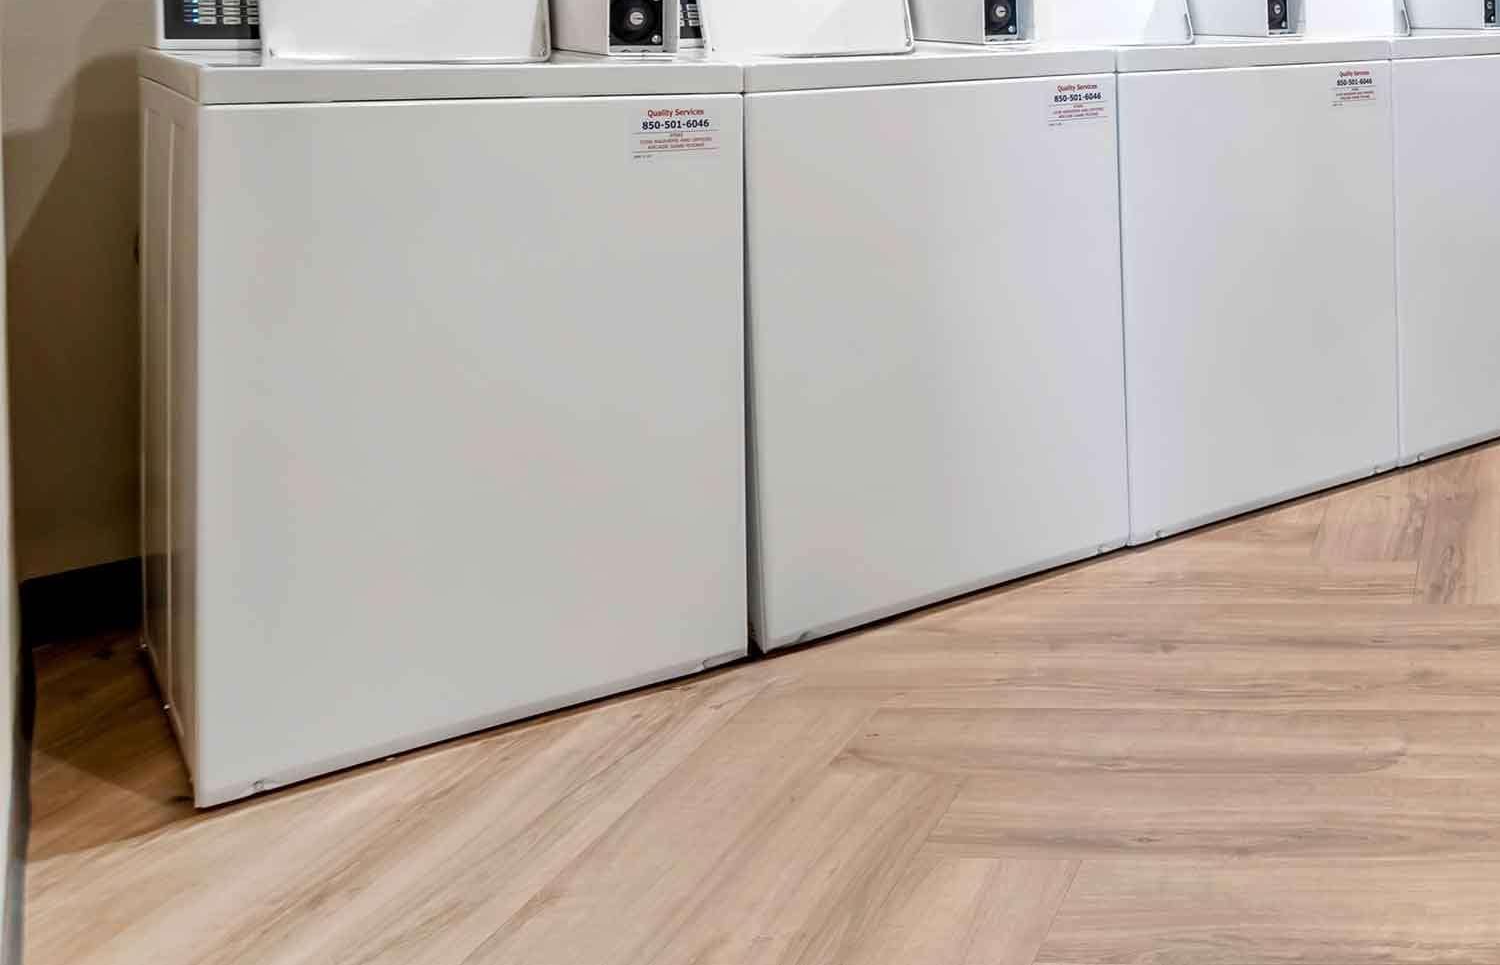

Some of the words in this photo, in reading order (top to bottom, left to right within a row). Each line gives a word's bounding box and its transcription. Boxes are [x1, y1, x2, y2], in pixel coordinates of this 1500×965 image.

[1054, 92, 1102, 102] 850-501-6046
[648, 110, 673, 118] Quality
[642, 119, 710, 130] 850-501-6046
